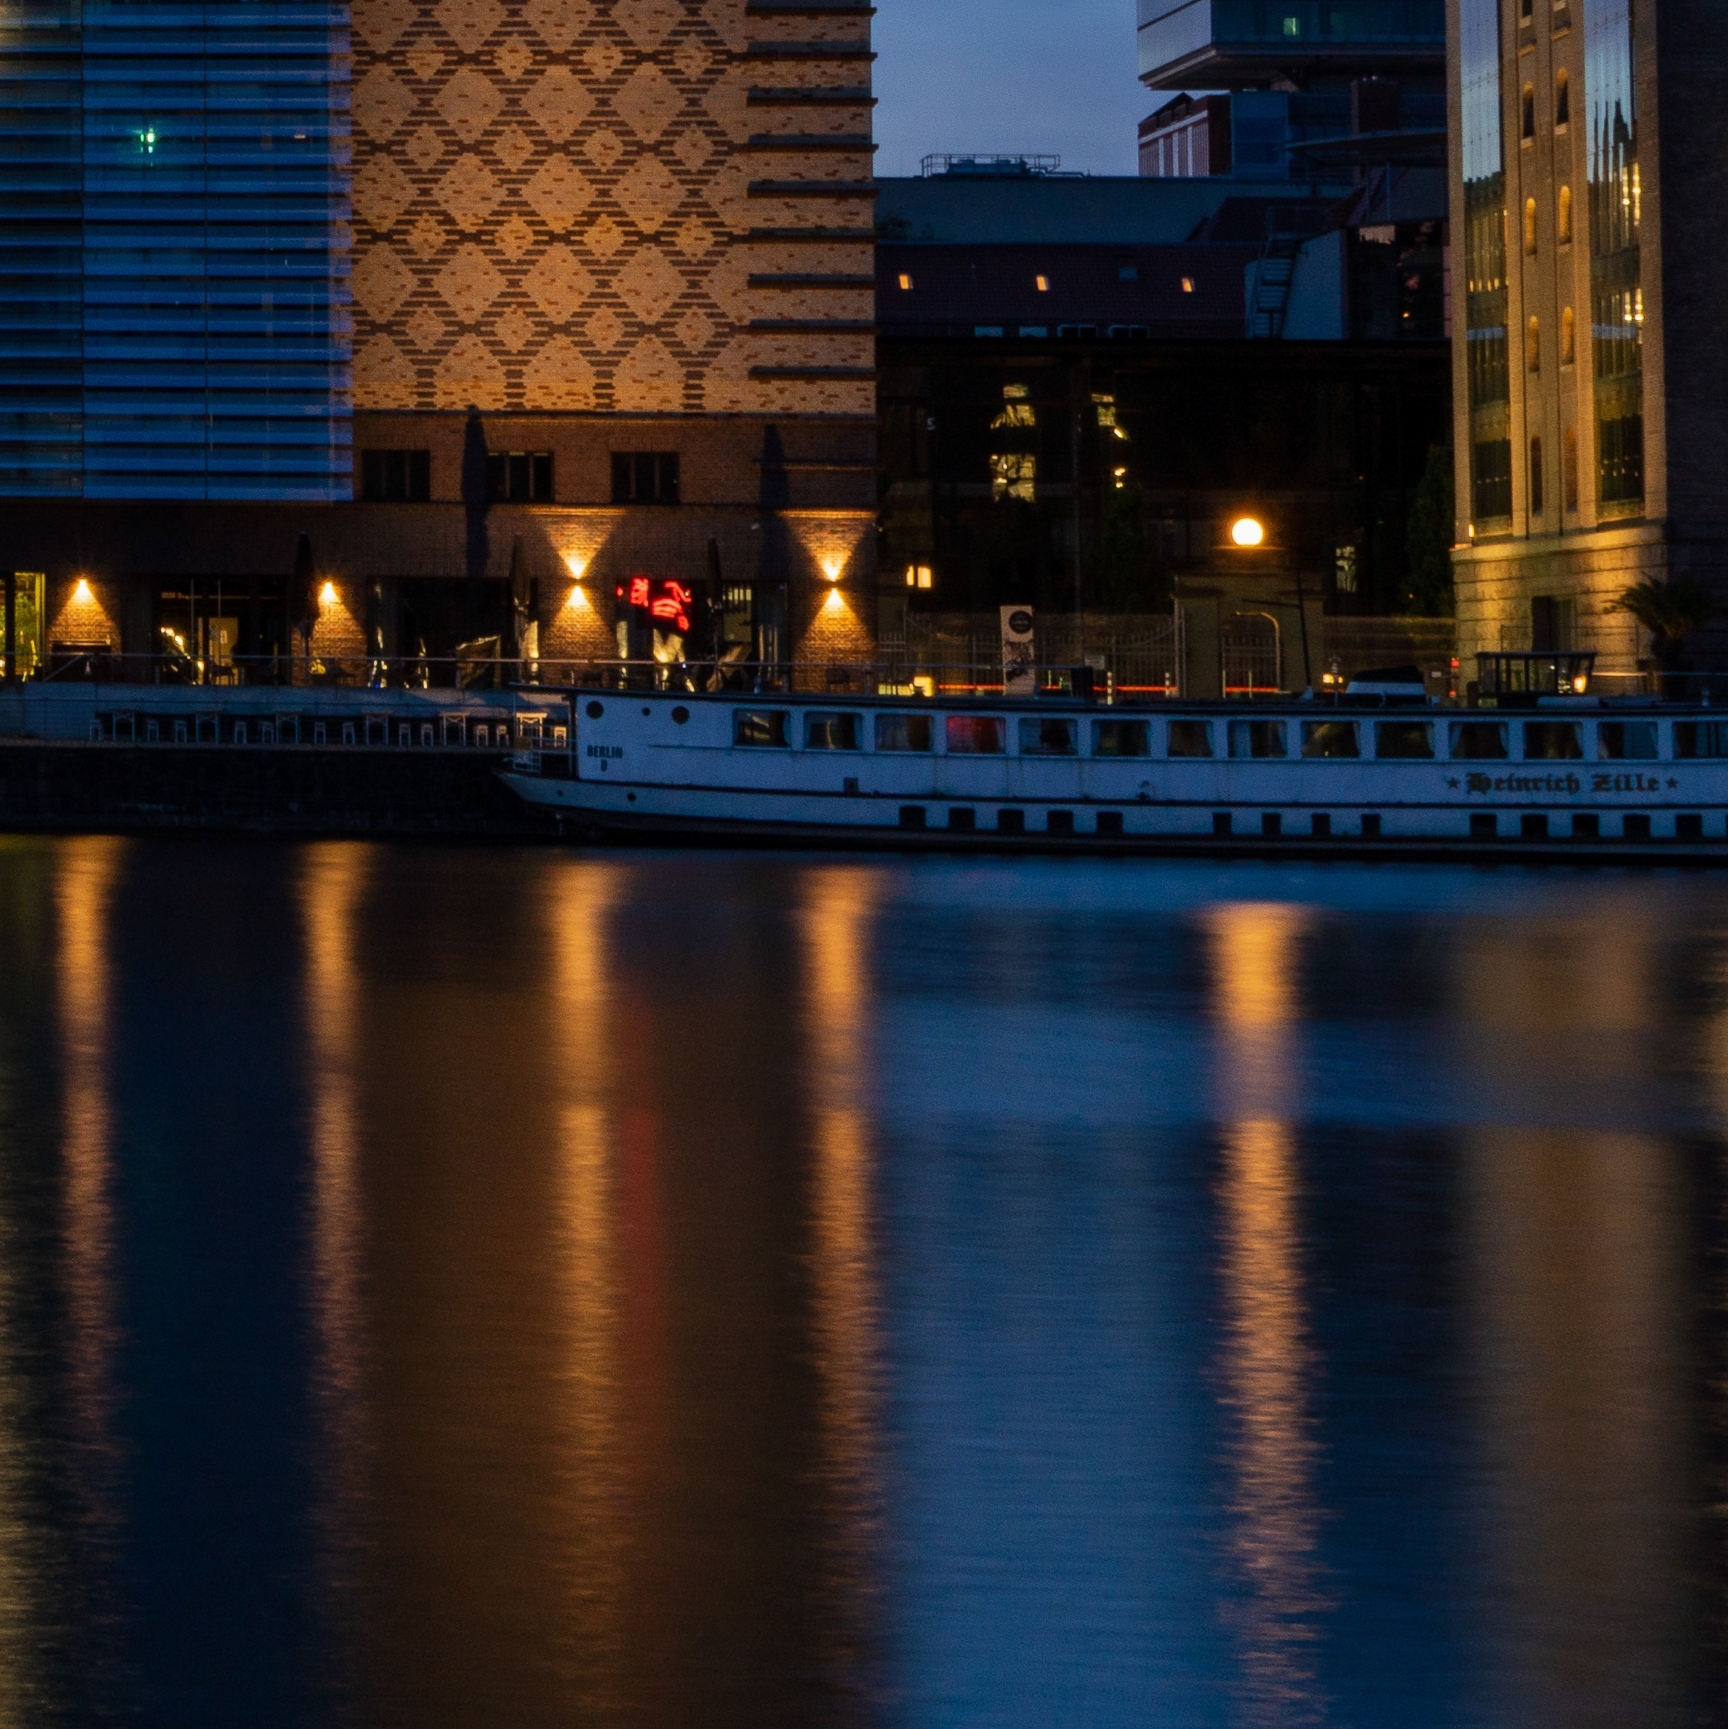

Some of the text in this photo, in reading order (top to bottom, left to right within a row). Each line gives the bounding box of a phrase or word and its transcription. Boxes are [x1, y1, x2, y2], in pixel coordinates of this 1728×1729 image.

[587, 745, 623, 759] BERLIN
[1466, 772, 1660, 795] Heinrich Zille
